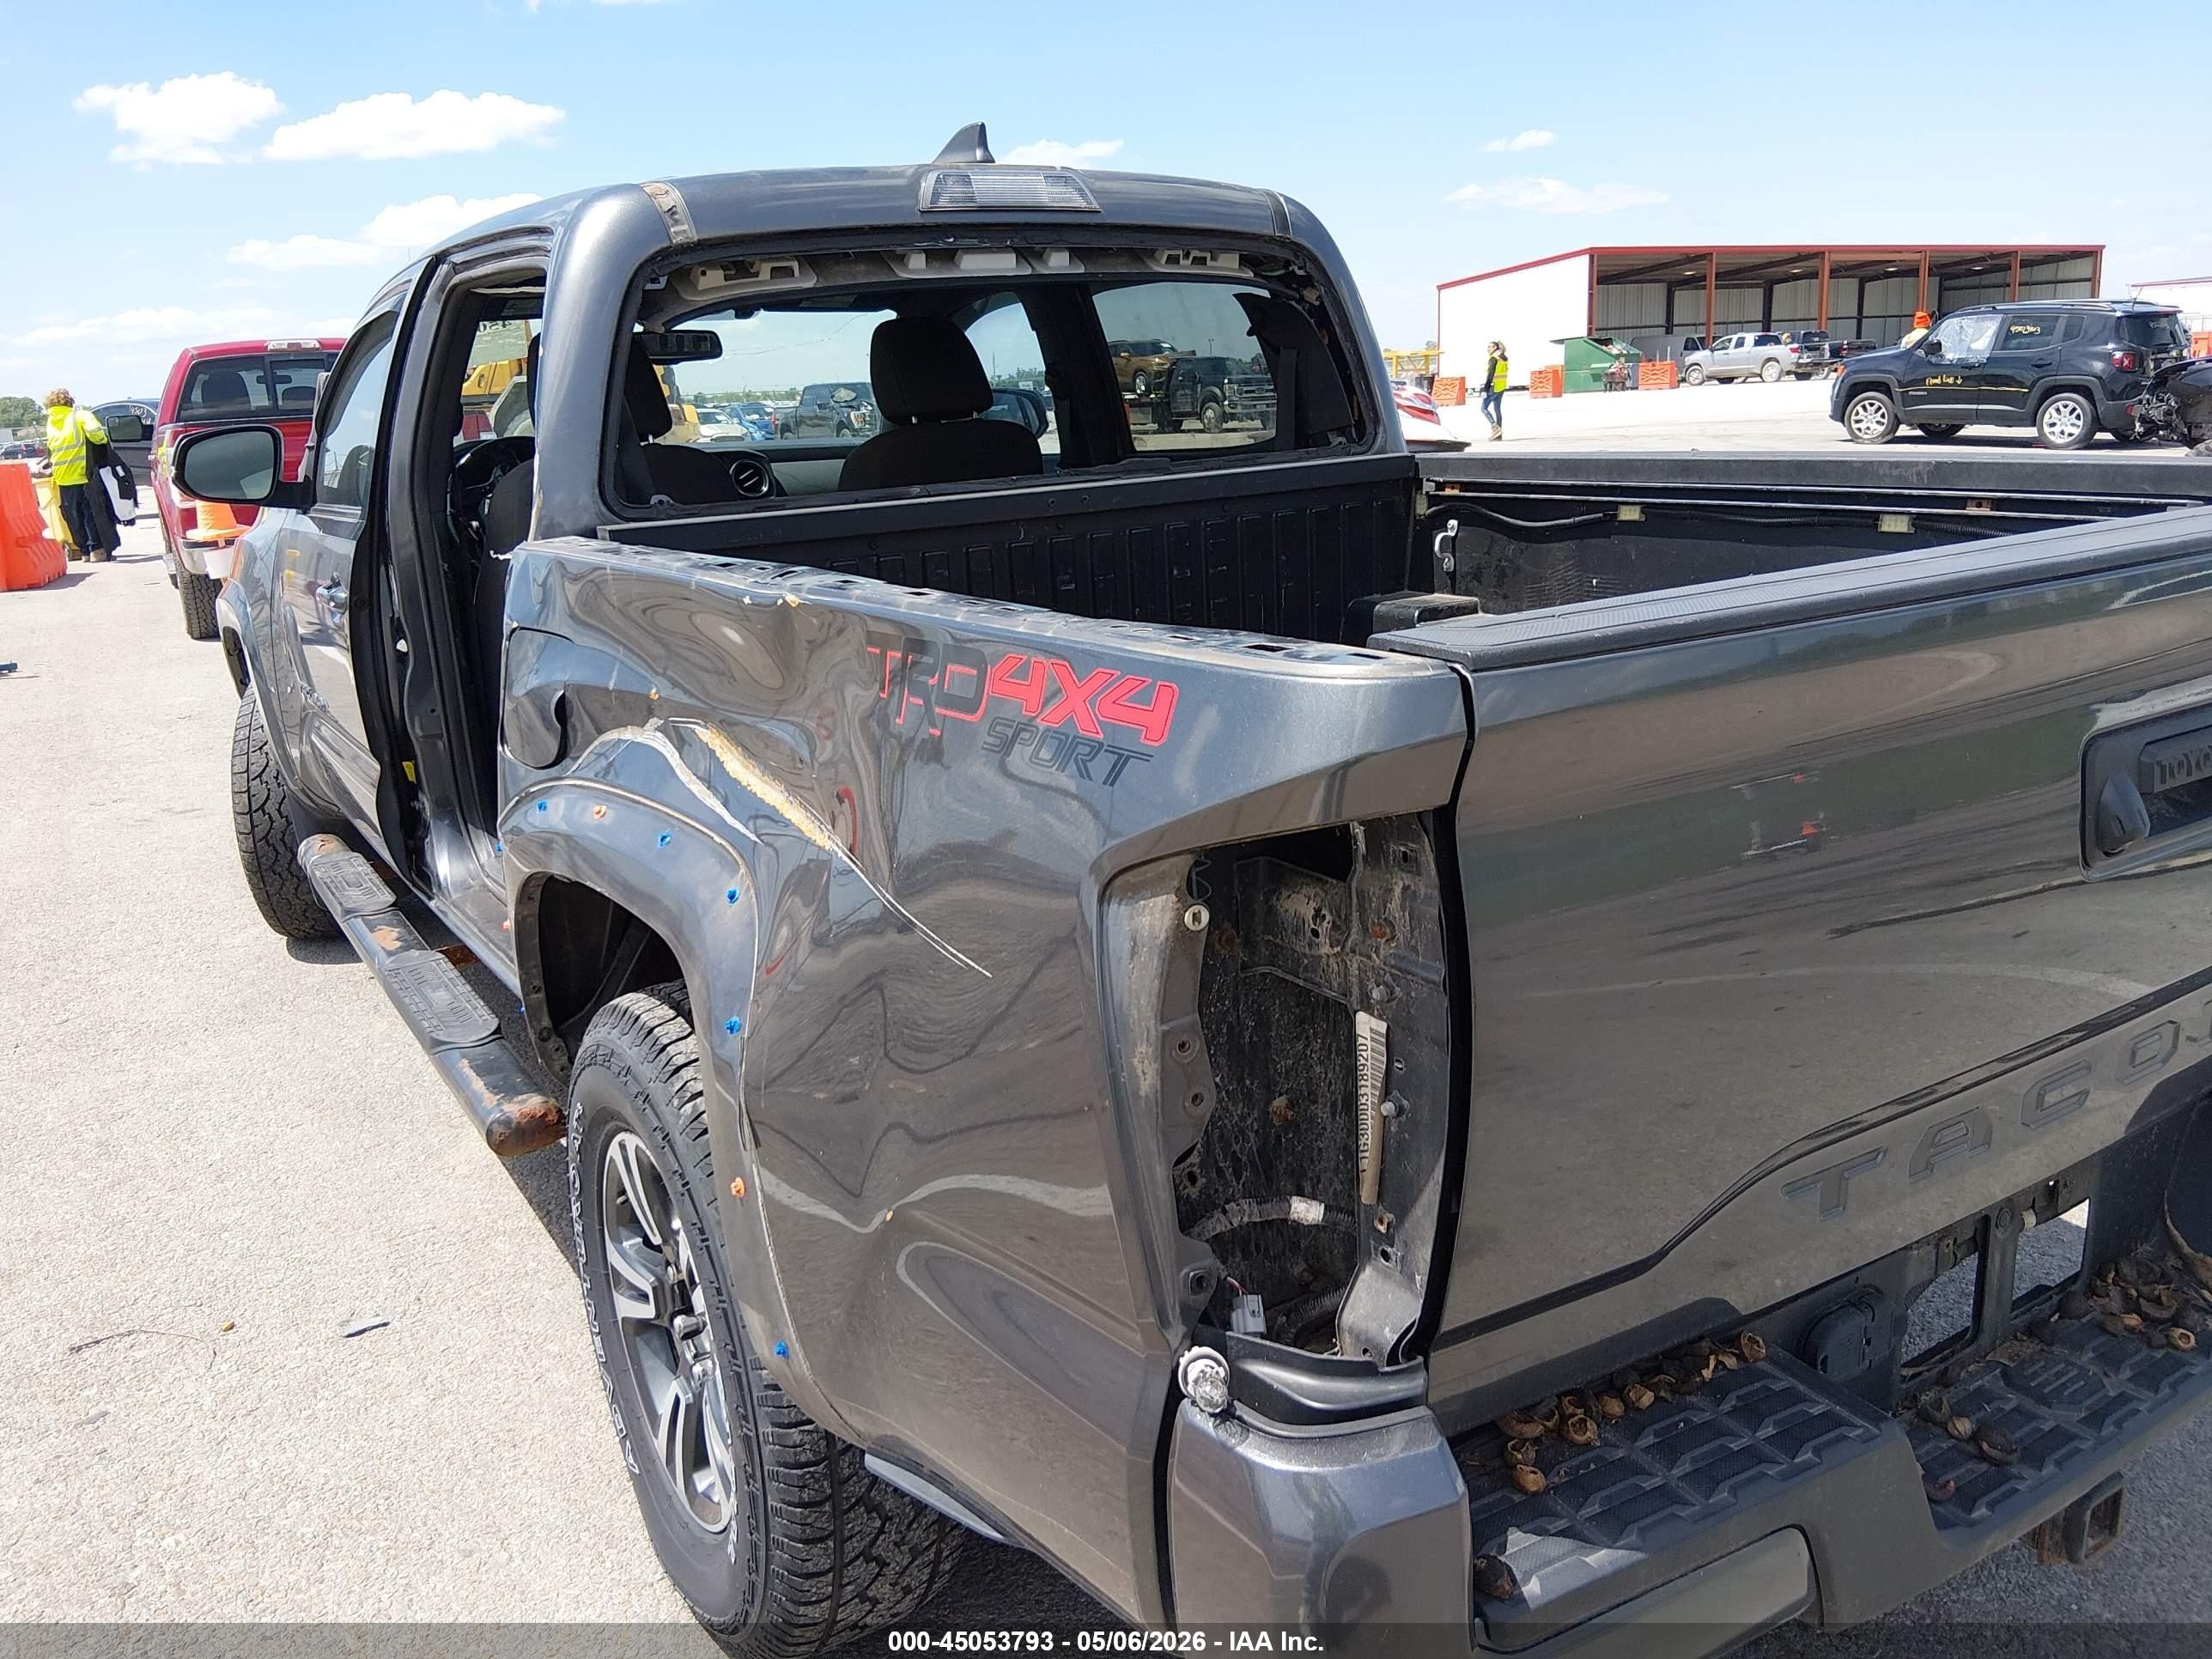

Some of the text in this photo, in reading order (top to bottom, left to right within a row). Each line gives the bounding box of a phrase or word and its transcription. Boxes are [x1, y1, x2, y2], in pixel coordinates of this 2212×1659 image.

[866, 629, 1180, 747] TRD 4X4
[981, 715, 1154, 787] SPORT
[2156, 744, 2212, 785] TOYO
